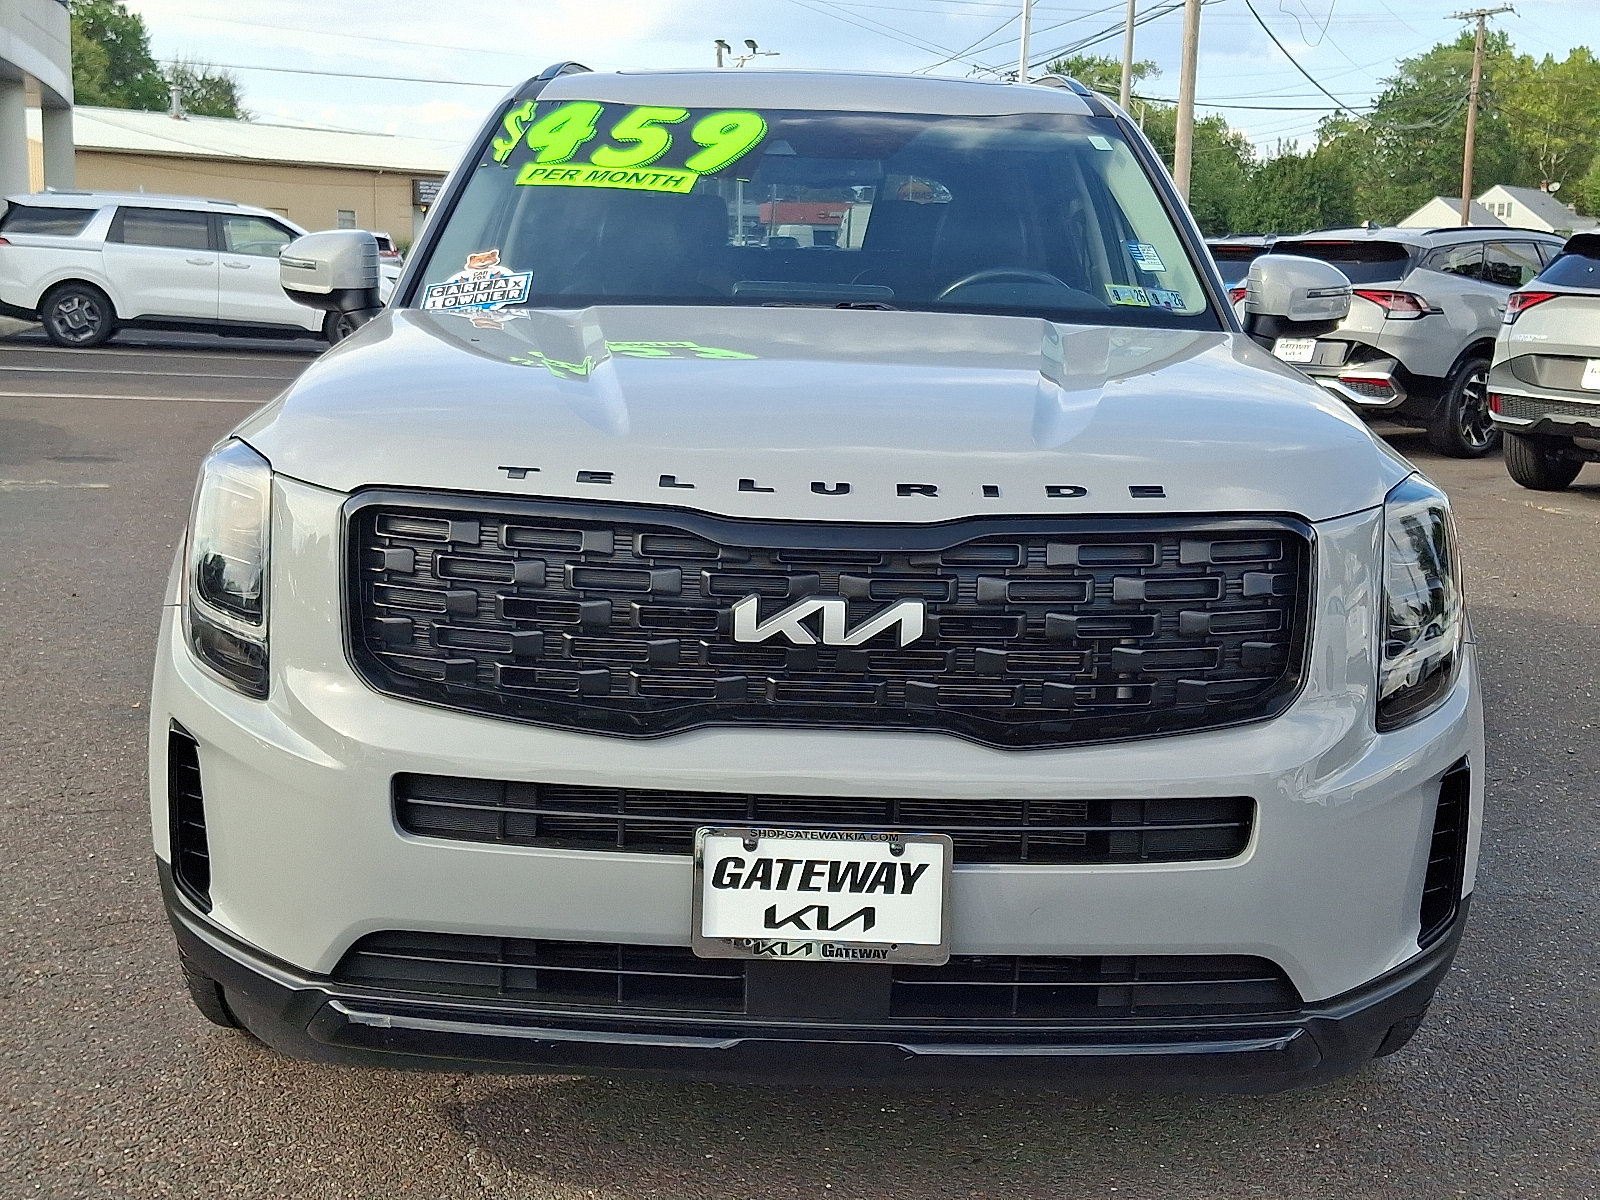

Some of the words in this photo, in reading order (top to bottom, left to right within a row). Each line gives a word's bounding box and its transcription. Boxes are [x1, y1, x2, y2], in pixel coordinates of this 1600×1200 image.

[493, 101, 768, 176] $459
[527, 168, 577, 182] PER
[584, 170, 686, 188] MONTH
[430, 279, 523, 298] CARFAX
[441, 288, 522, 308] OWNER
[498, 466, 1166, 498] TELLURIDE
[733, 594, 926, 648] KIA
[750, 829, 899, 842] SHOPGATEWAYKIA.COM
[711, 856, 930, 895] GATEWAY
[764, 904, 876, 932] KIA
[753, 941, 812, 957] KIA
[821, 943, 888, 959] GATEWAY
